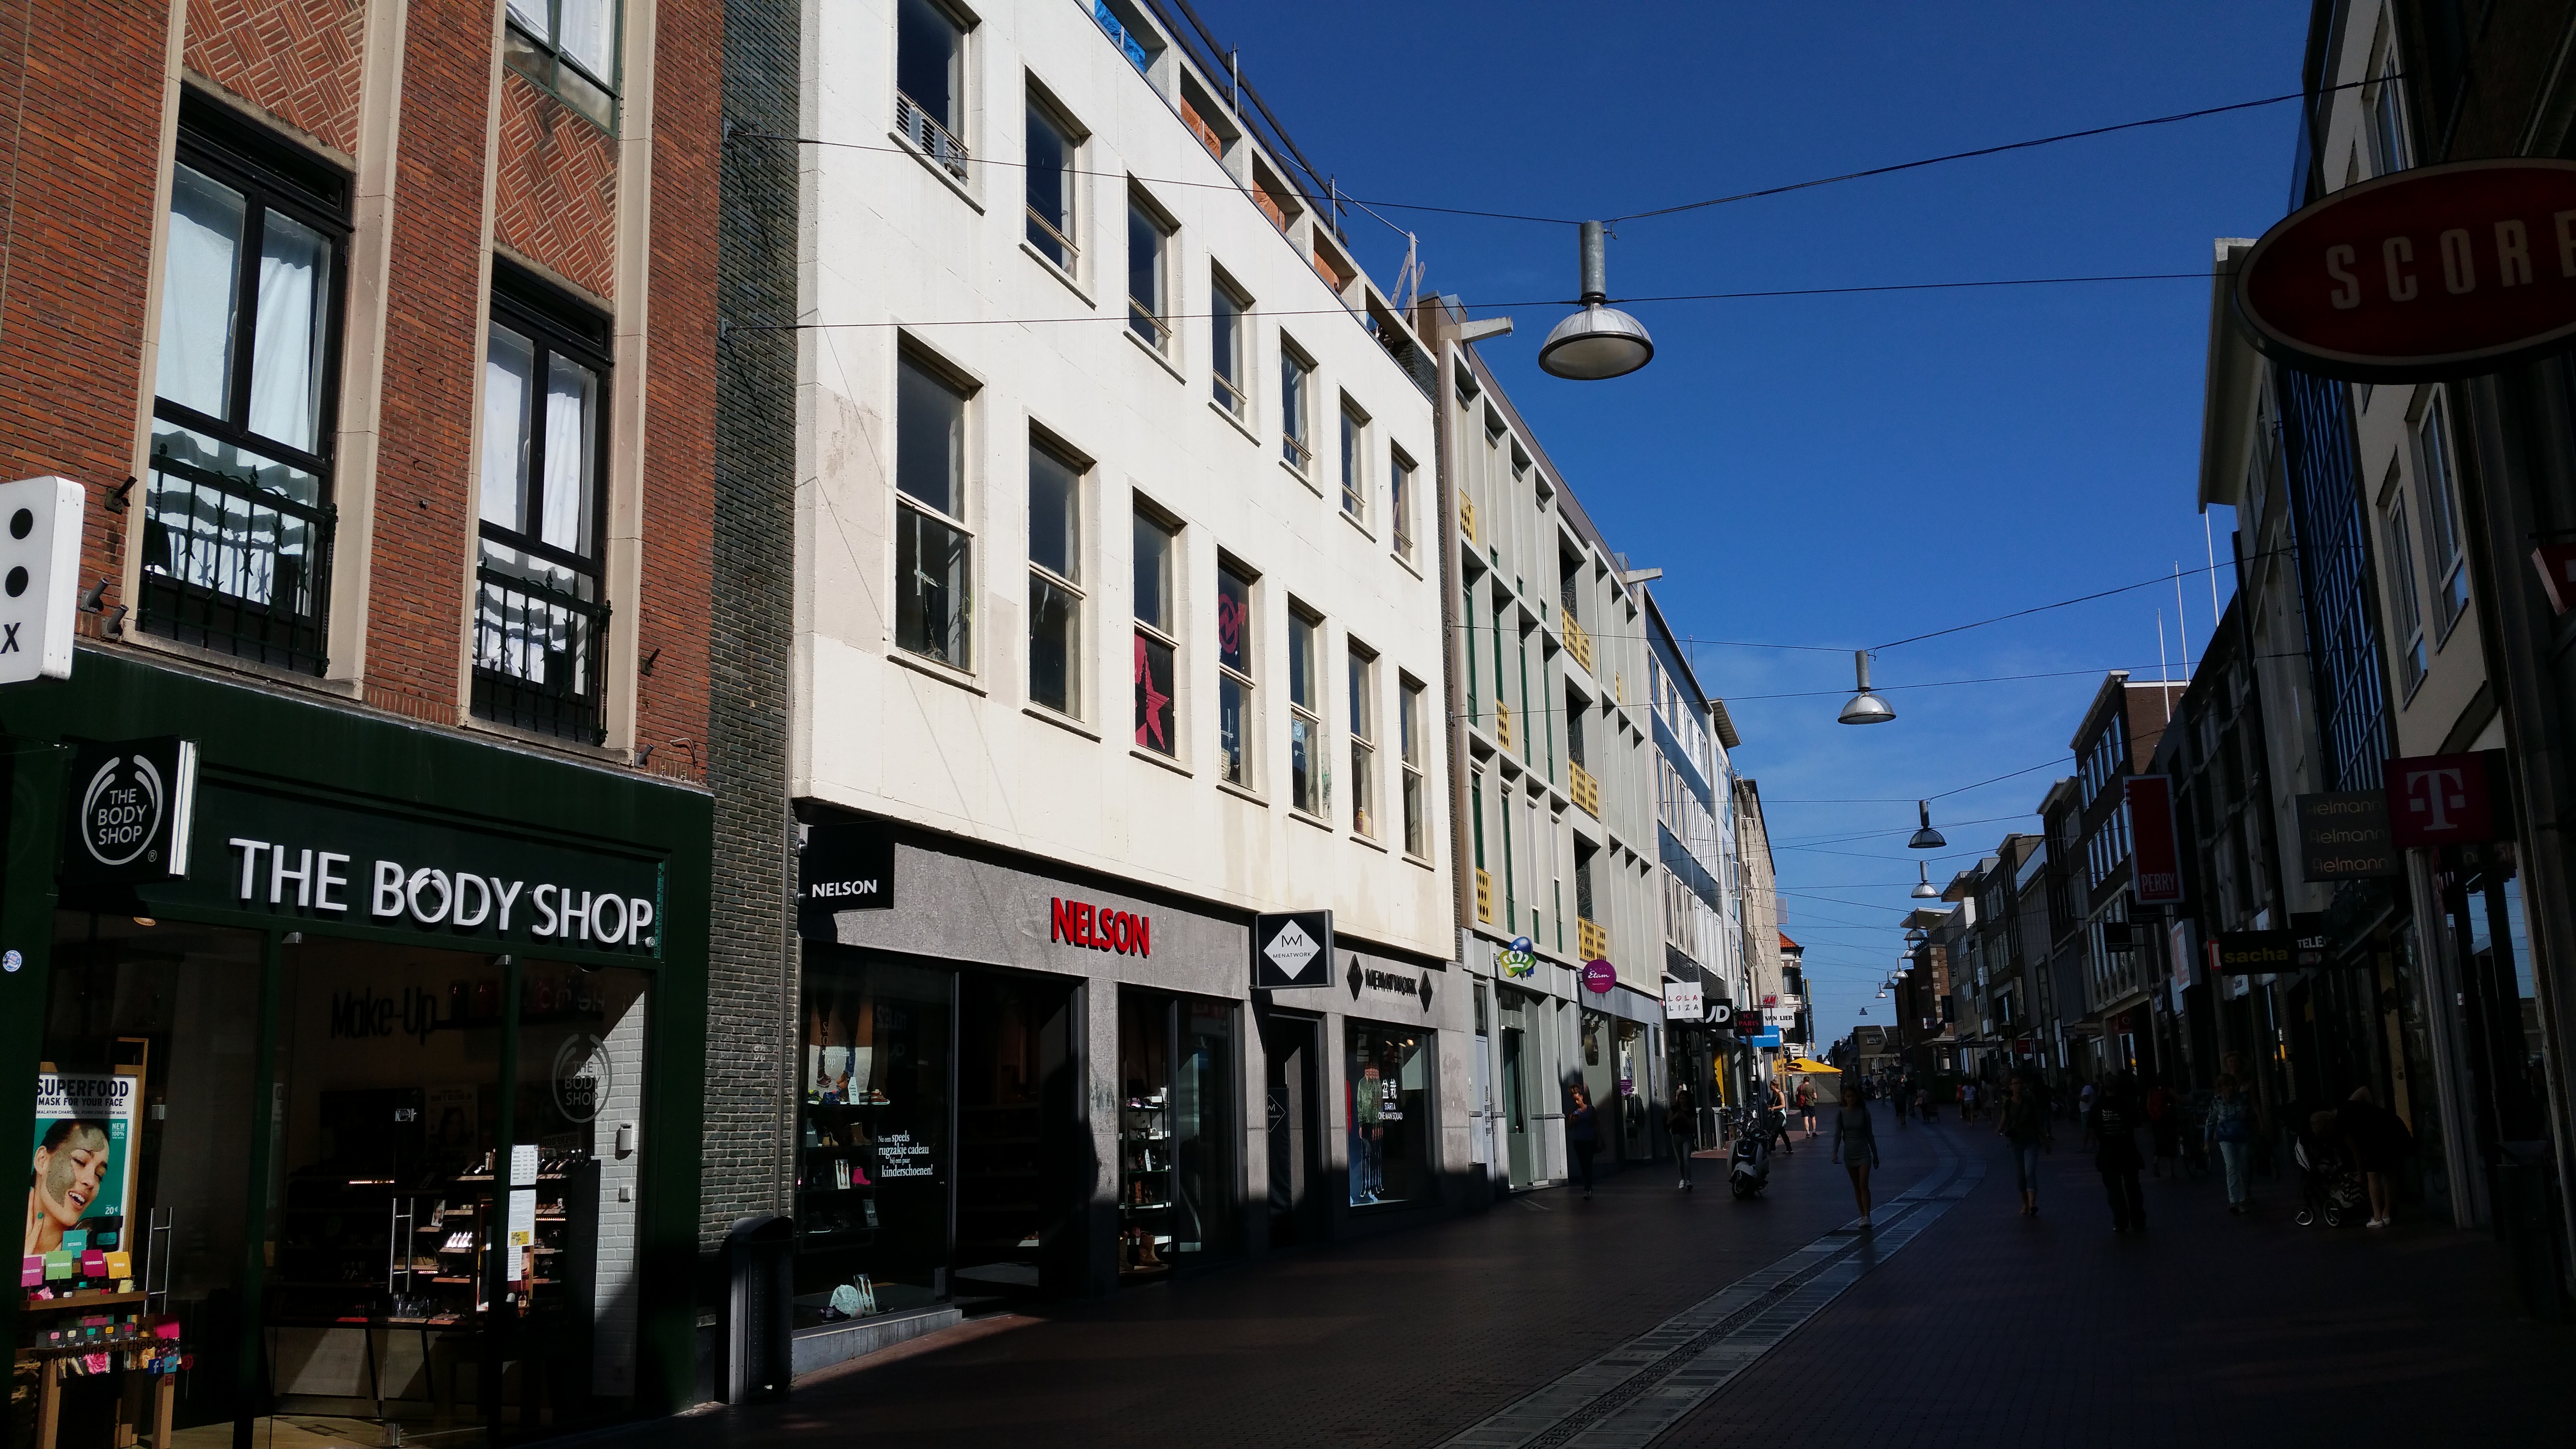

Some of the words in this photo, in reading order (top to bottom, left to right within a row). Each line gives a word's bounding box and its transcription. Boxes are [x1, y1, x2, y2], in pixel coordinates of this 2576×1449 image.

[110, 789, 137, 805] THE
[97, 805, 147, 826] BODY
[98, 825, 143, 845] SHOP
[812, 879, 877, 898] NELSON
[2141, 873, 2174, 891] PERRY
[229, 838, 350, 912] THE
[372, 860, 524, 930] BODY
[531, 884, 653, 945] SHOP
[1051, 897, 1149, 958] NELSON
[2224, 948, 2288, 963] sacha
[1588, 970, 1610, 979] Etam
[1763, 996, 1776, 1005] H&M
[331, 986, 436, 1045] Make-Up
[1706, 1005, 1730, 1023] JD
[822, 1047, 850, 1059] schoolplein
[571, 1062, 593, 1074] THE
[827, 1058, 836, 1068] op
[37, 1079, 129, 1097] SUPERFOOD
[564, 1076, 601, 1090] BODY
[1382, 1079, 1397, 1099] 盆栽
[38, 1097, 60, 1106] MASK
[64, 1097, 78, 1106] FOR
[81, 1098, 103, 1106] YOUR
[105, 1098, 123, 1107] FACE
[565, 1092, 598, 1106] SHOP
[1393, 1112, 1403, 1122] SQUAD
[892, 1130, 910, 1146] speels
[878, 1142, 907, 1159] rugzakje
[908, 1142, 929, 1154] cadeau
[881, 1164, 933, 1177] kinderschoenen!
[66, 1344, 106, 1358] online
